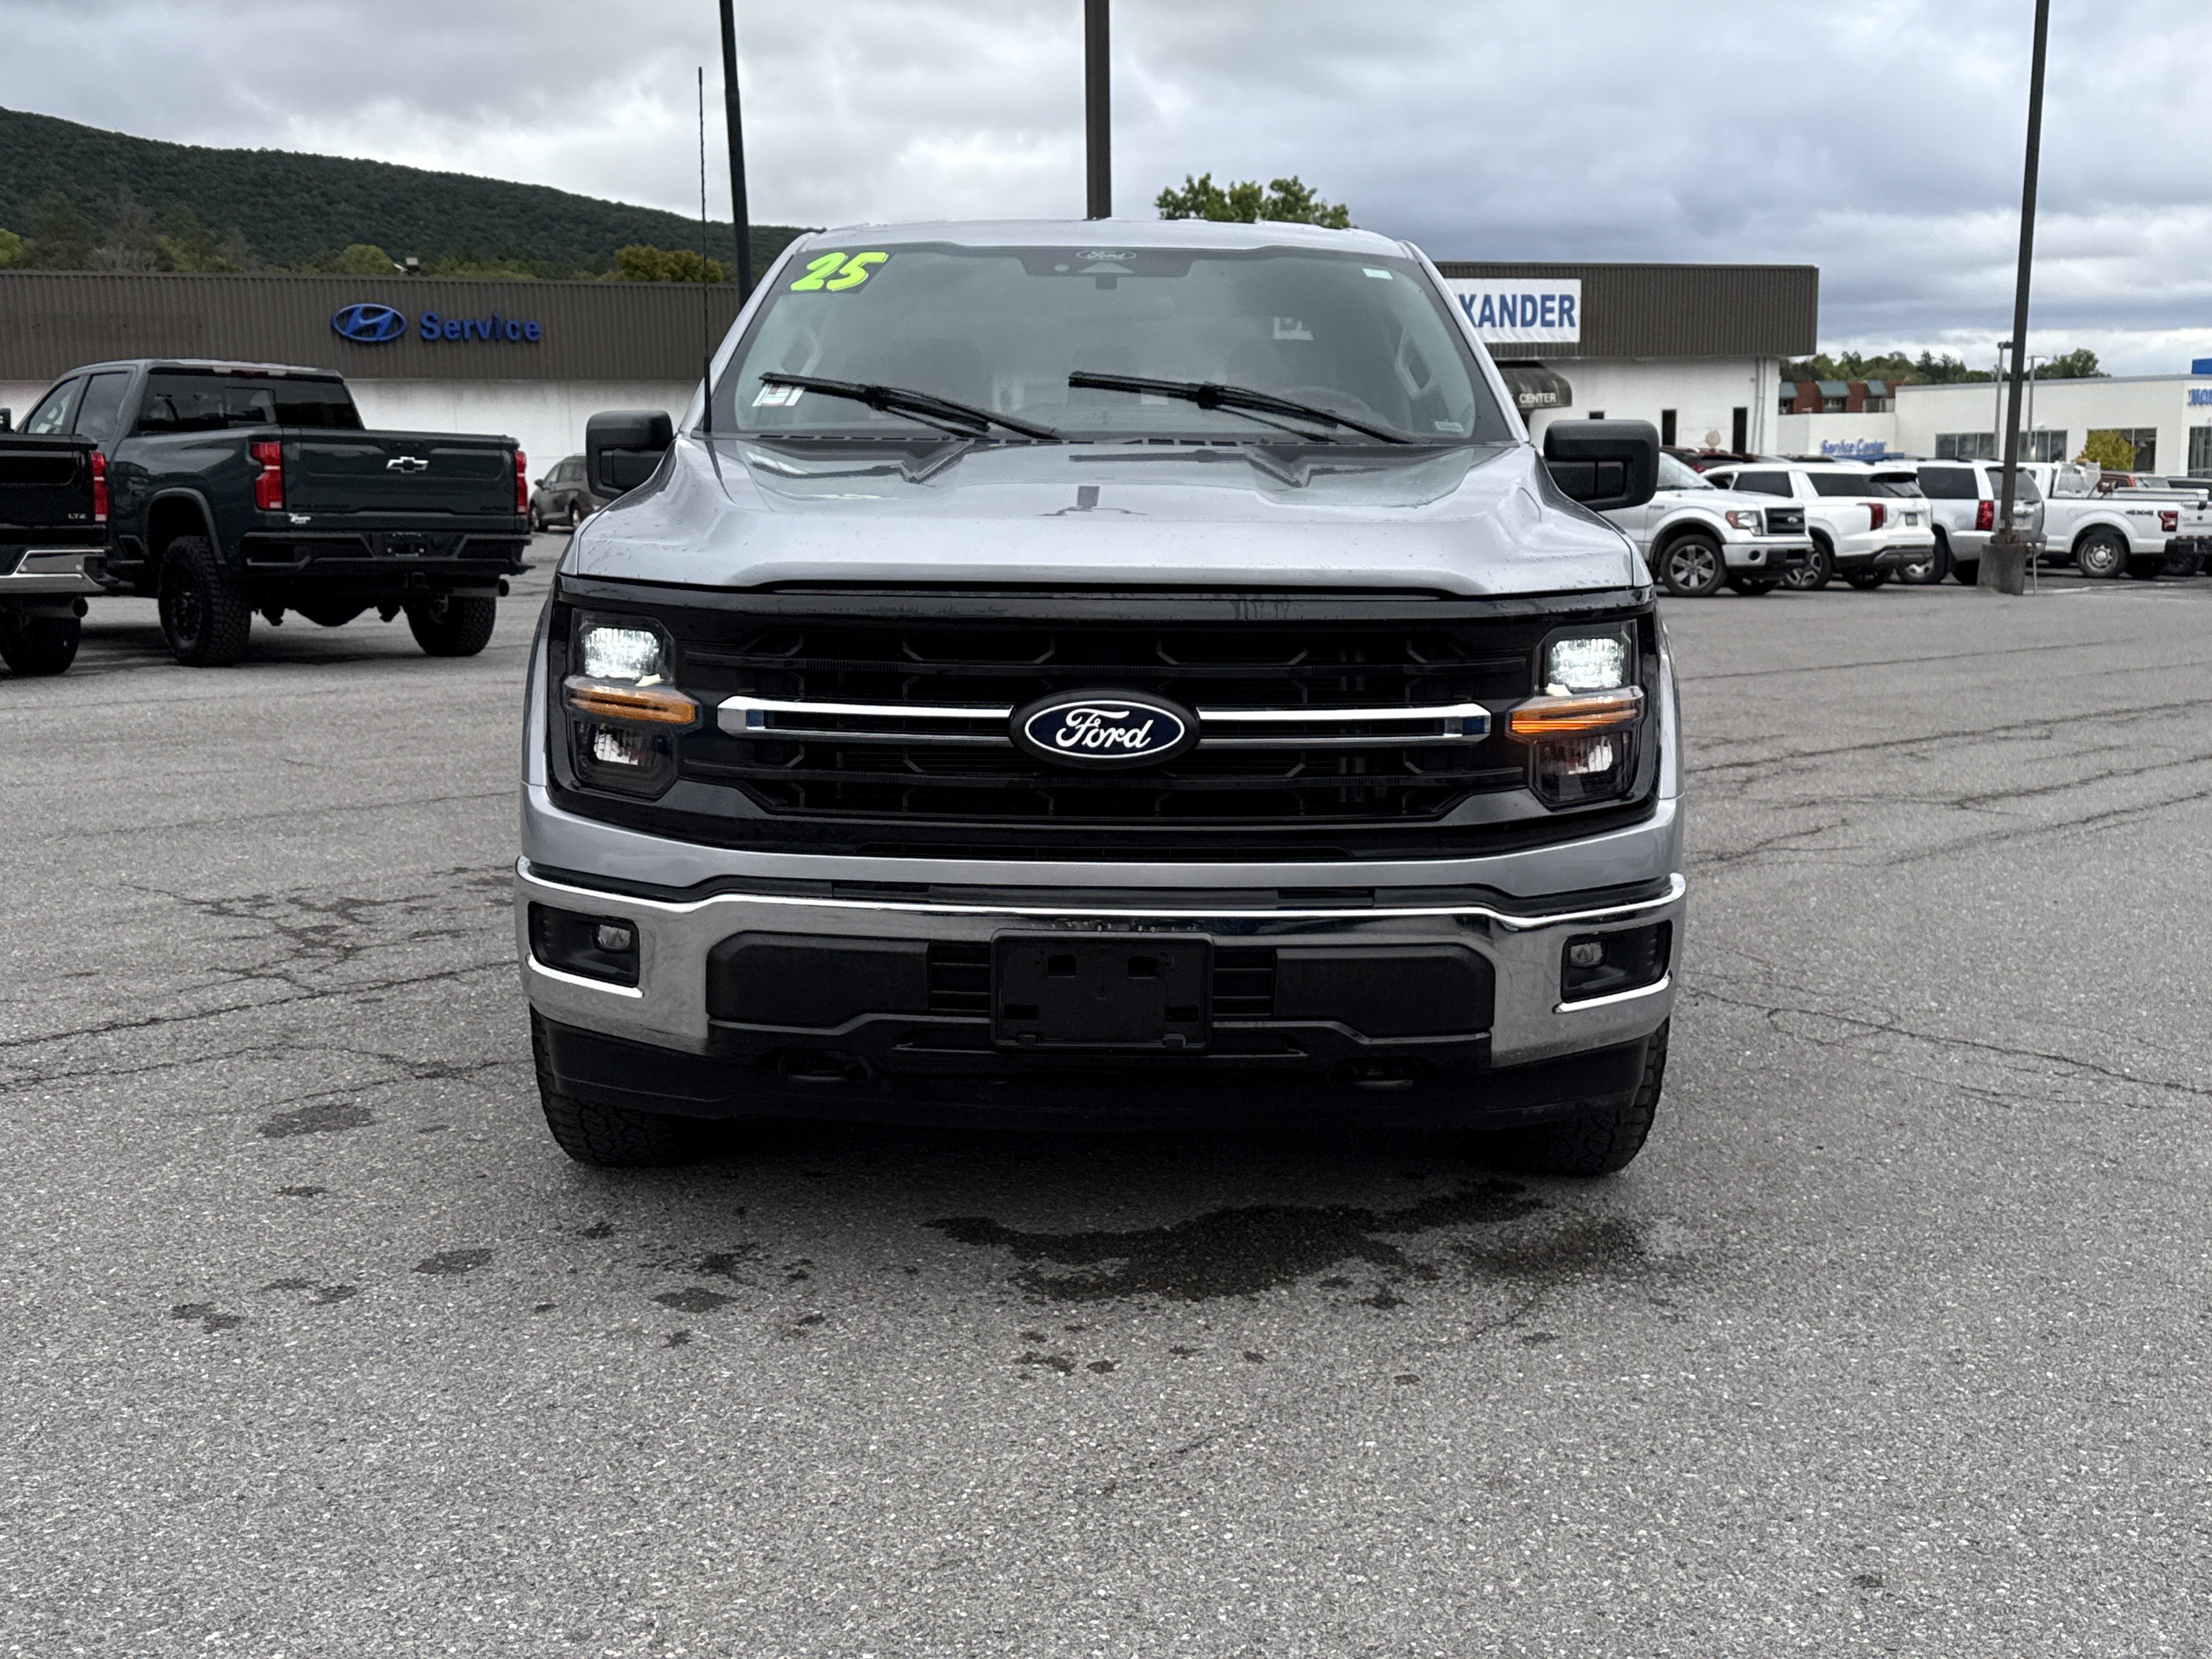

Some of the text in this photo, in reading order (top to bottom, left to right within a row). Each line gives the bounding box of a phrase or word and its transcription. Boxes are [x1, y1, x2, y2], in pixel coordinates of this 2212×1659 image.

[791, 252, 889, 291] 25
[420, 311, 541, 342] Service
[1519, 392, 1556, 404] CENTER
[1822, 438, 1887, 453] Service Center
[1056, 708, 1154, 748] Ford
